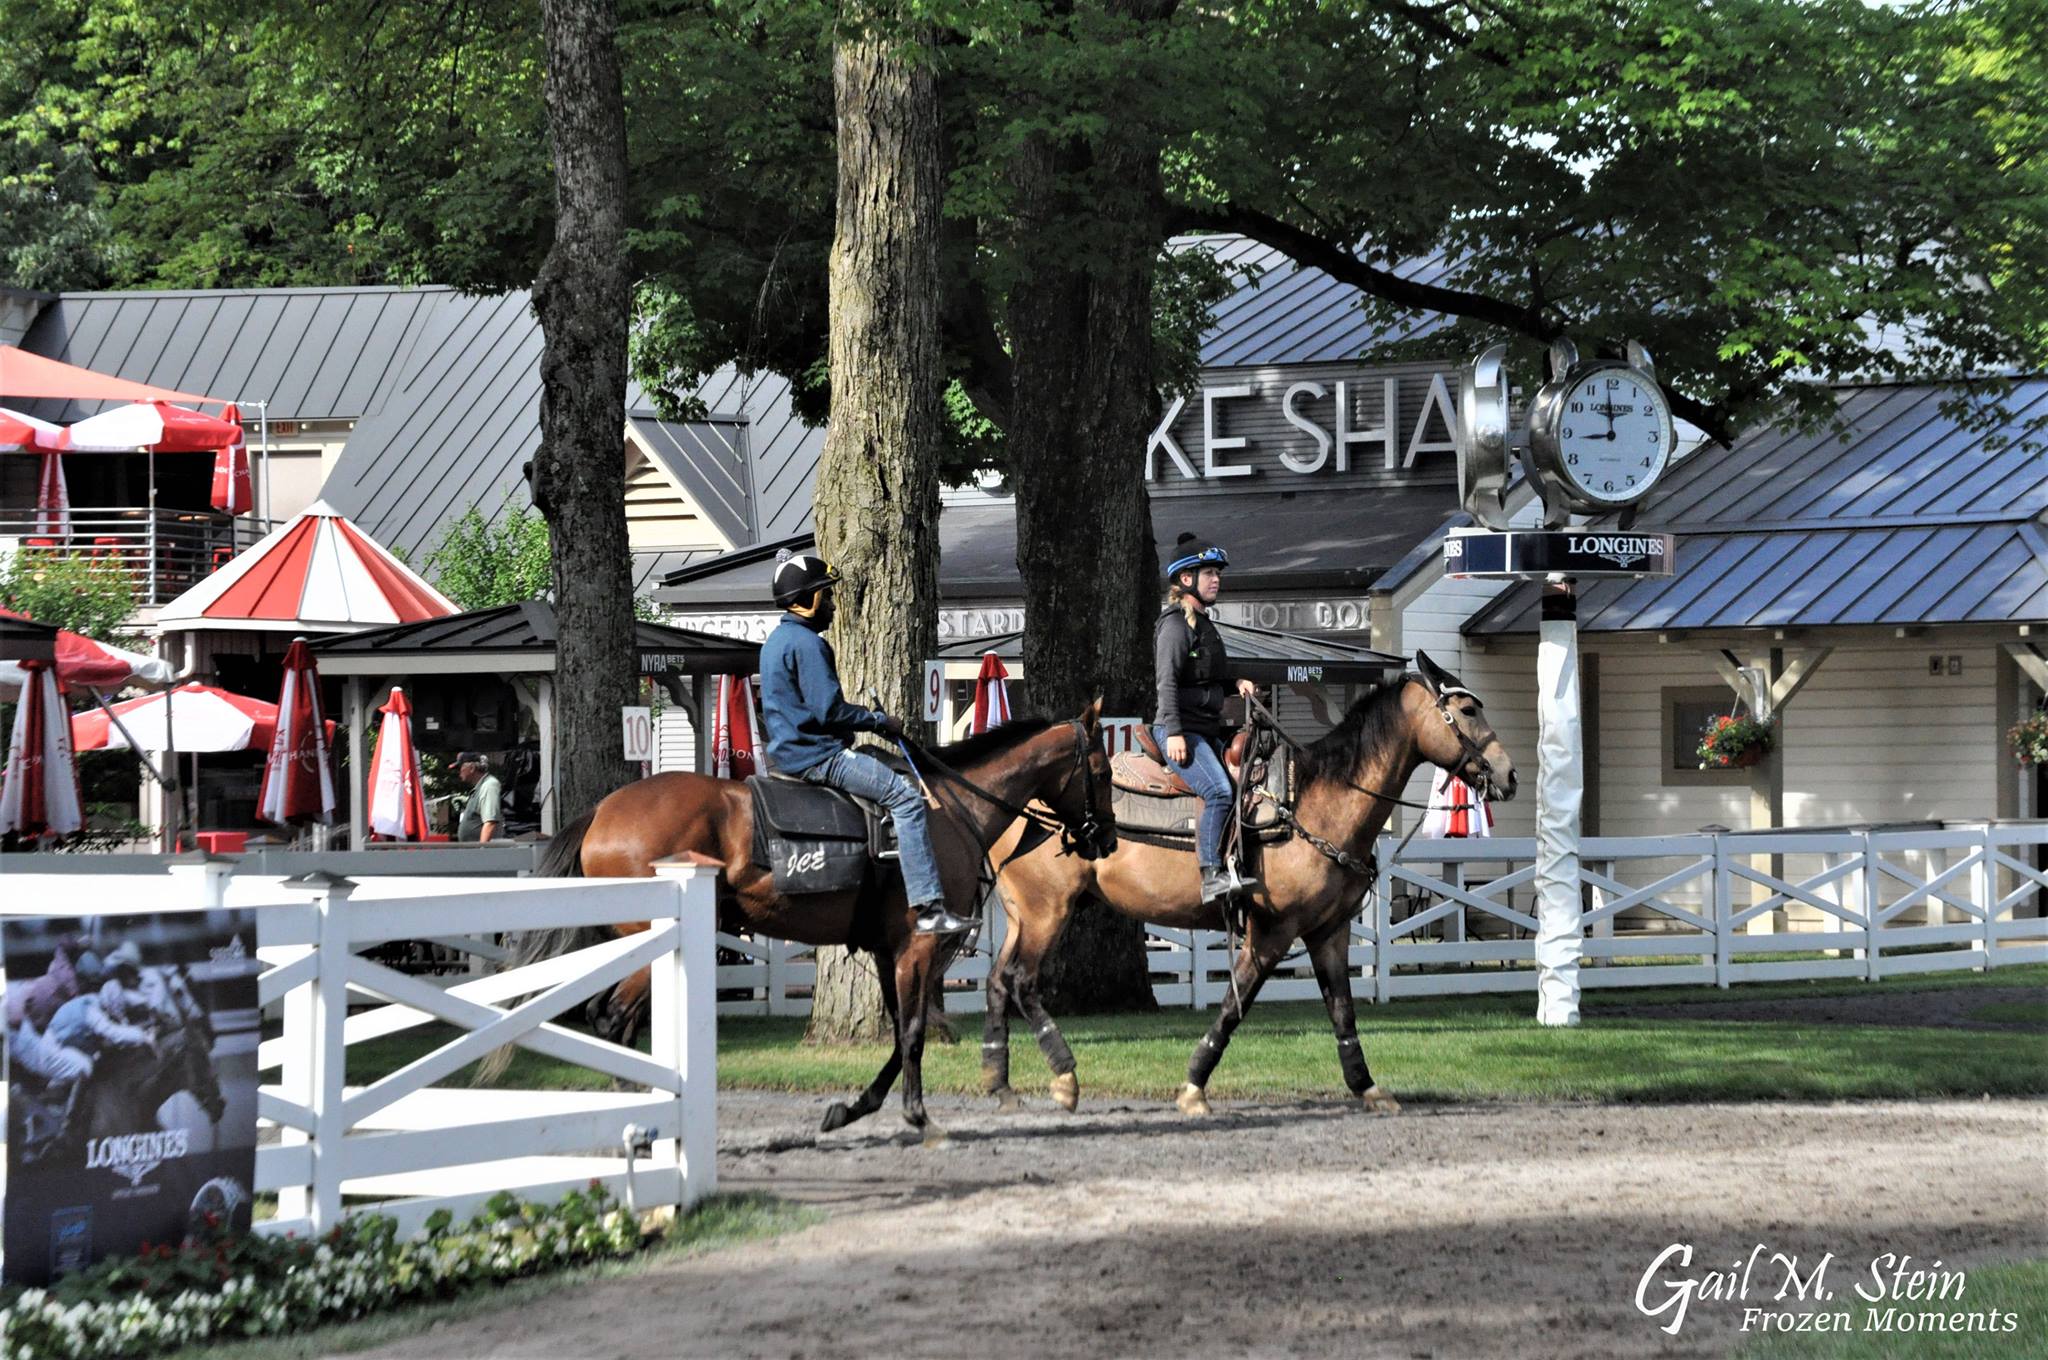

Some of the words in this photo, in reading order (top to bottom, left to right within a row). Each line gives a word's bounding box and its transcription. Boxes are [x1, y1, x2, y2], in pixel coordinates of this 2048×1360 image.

[1586, 385, 1596, 396] 11
[1632, 387, 1637, 398] 1
[1570, 401, 1584, 413] 10
[1590, 403, 1633, 413] LONINES
[1643, 405, 1653, 416] 2
[1562, 427, 1573, 439] 9
[1648, 431, 1658, 443] 3
[1568, 453, 1578, 465] 8
[1640, 457, 1651, 468] 4
[1583, 473, 1593, 485] 7
[1625, 475, 1635, 487] 5
[1604, 480, 1614, 492] 6
[1568, 536, 1664, 556] LONGINES
[1242, 602, 1296, 629] HOT
[641, 653, 667, 673] NYRA
[667, 654, 685, 664] BETS
[1287, 665, 1309, 682] NYRA
[1308, 666, 1323, 674] BETS
[930, 668, 940, 714] 9
[626, 715, 650, 755] 10
[1104, 723, 1132, 758] 11
[85, 1127, 189, 1170] LONGINES
